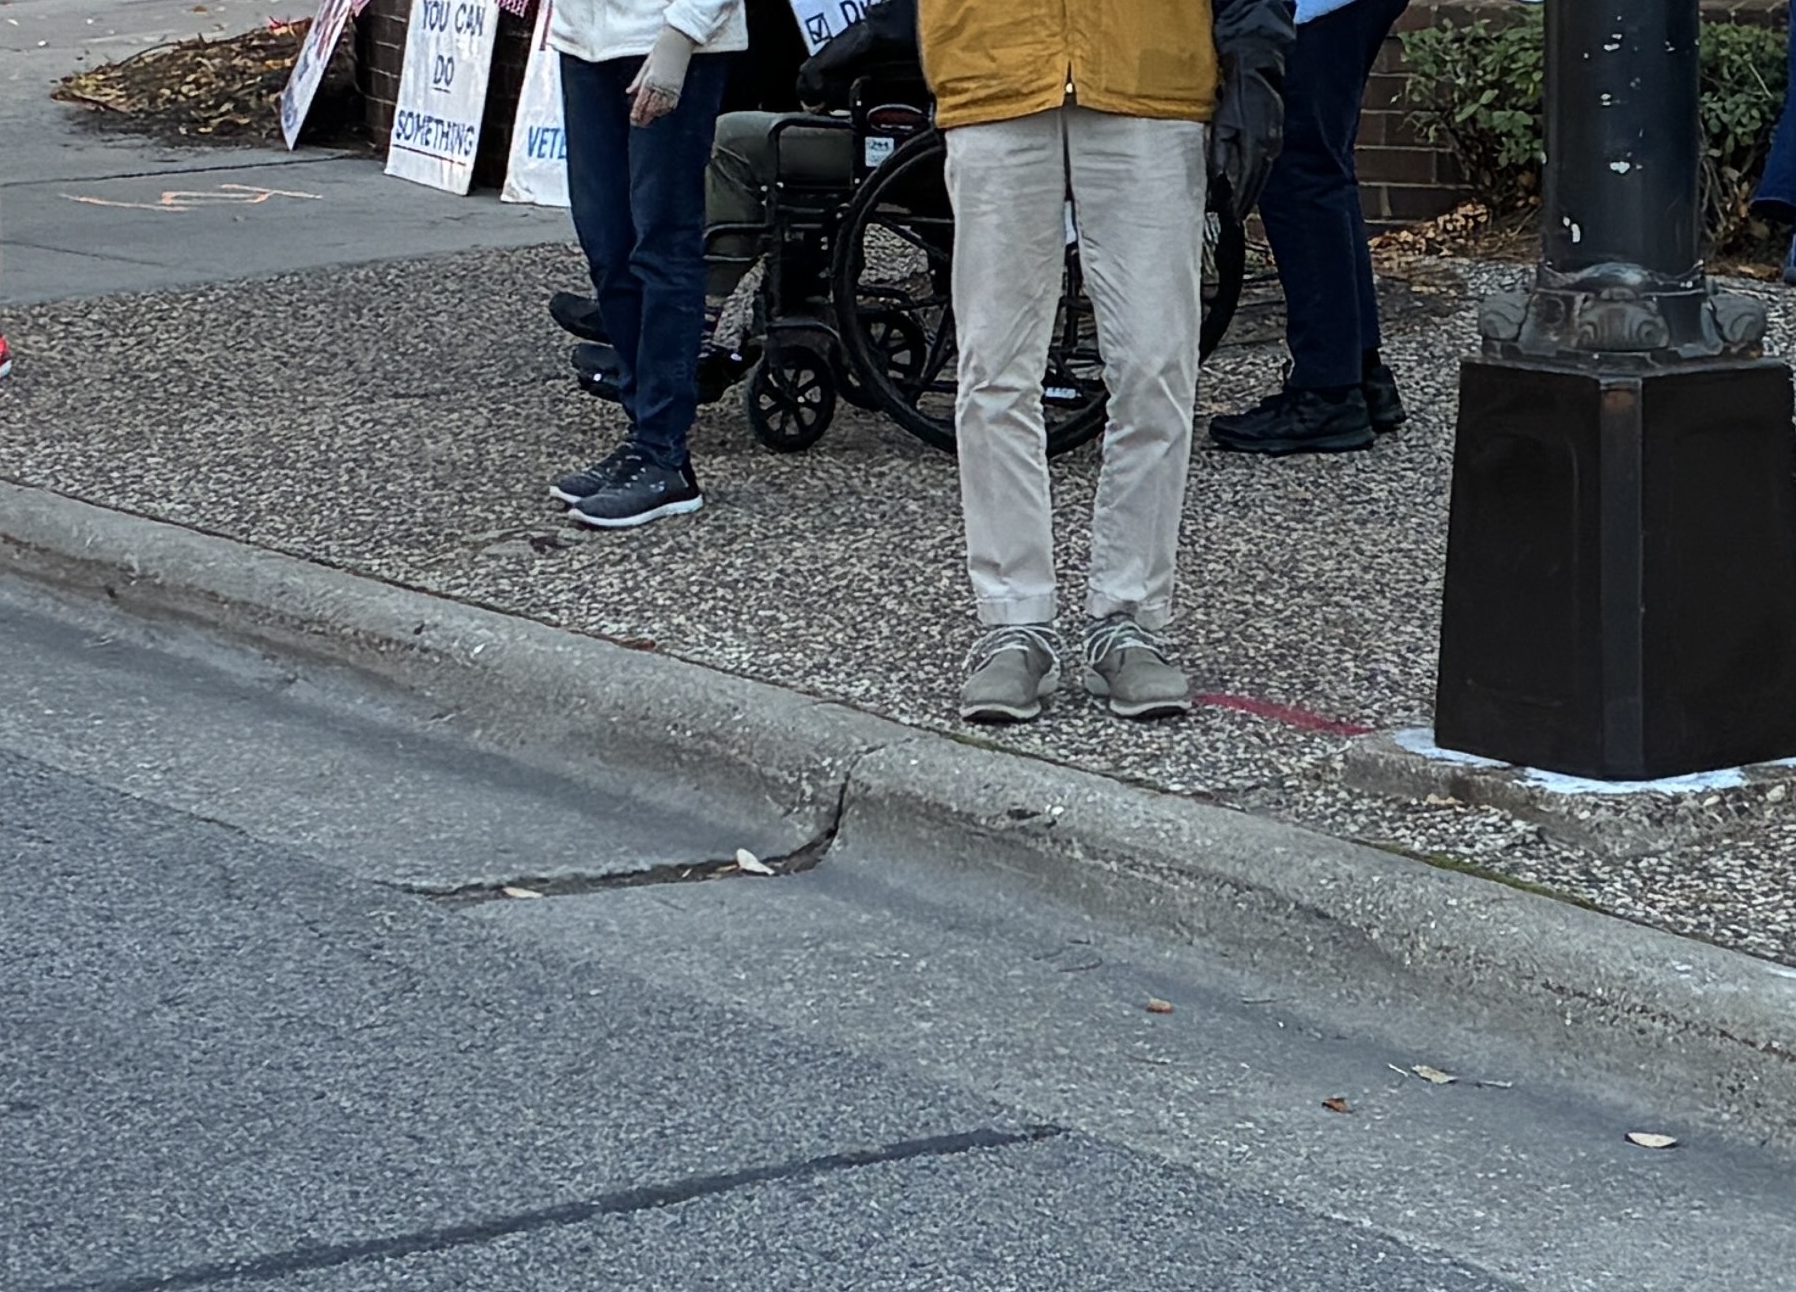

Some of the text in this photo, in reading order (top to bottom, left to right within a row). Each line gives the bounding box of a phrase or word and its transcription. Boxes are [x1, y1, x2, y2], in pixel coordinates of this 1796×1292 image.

[455, 2, 486, 37] CAN
[432, 54, 455, 88] DO
[395, 109, 475, 158] SOMETHING
